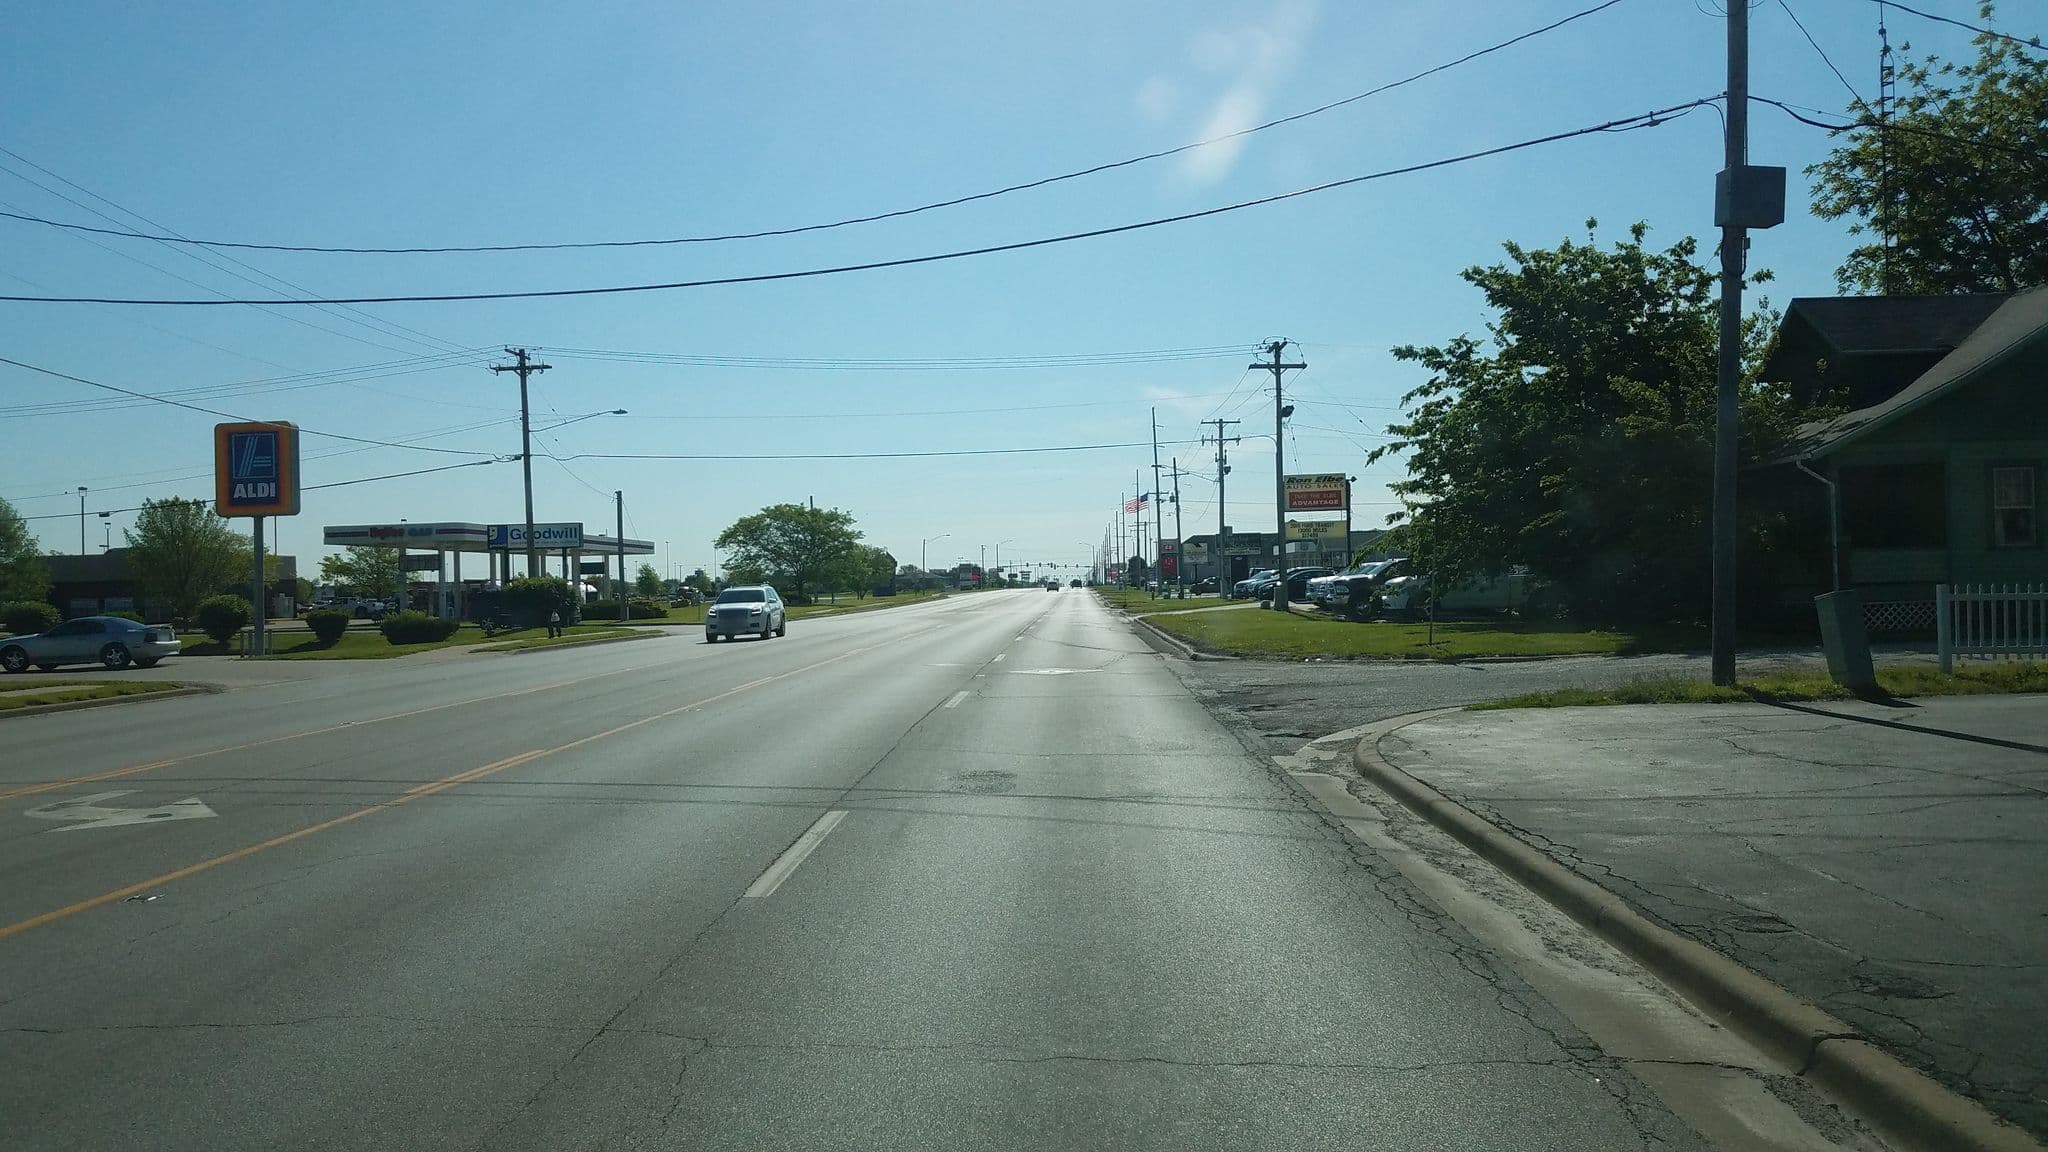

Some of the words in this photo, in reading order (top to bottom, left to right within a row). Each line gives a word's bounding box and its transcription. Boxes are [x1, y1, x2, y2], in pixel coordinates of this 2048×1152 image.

[1314, 475, 1343, 483] Elbe
[233, 482, 276, 498] ALDI
[510, 527, 578, 540] Goodwill
